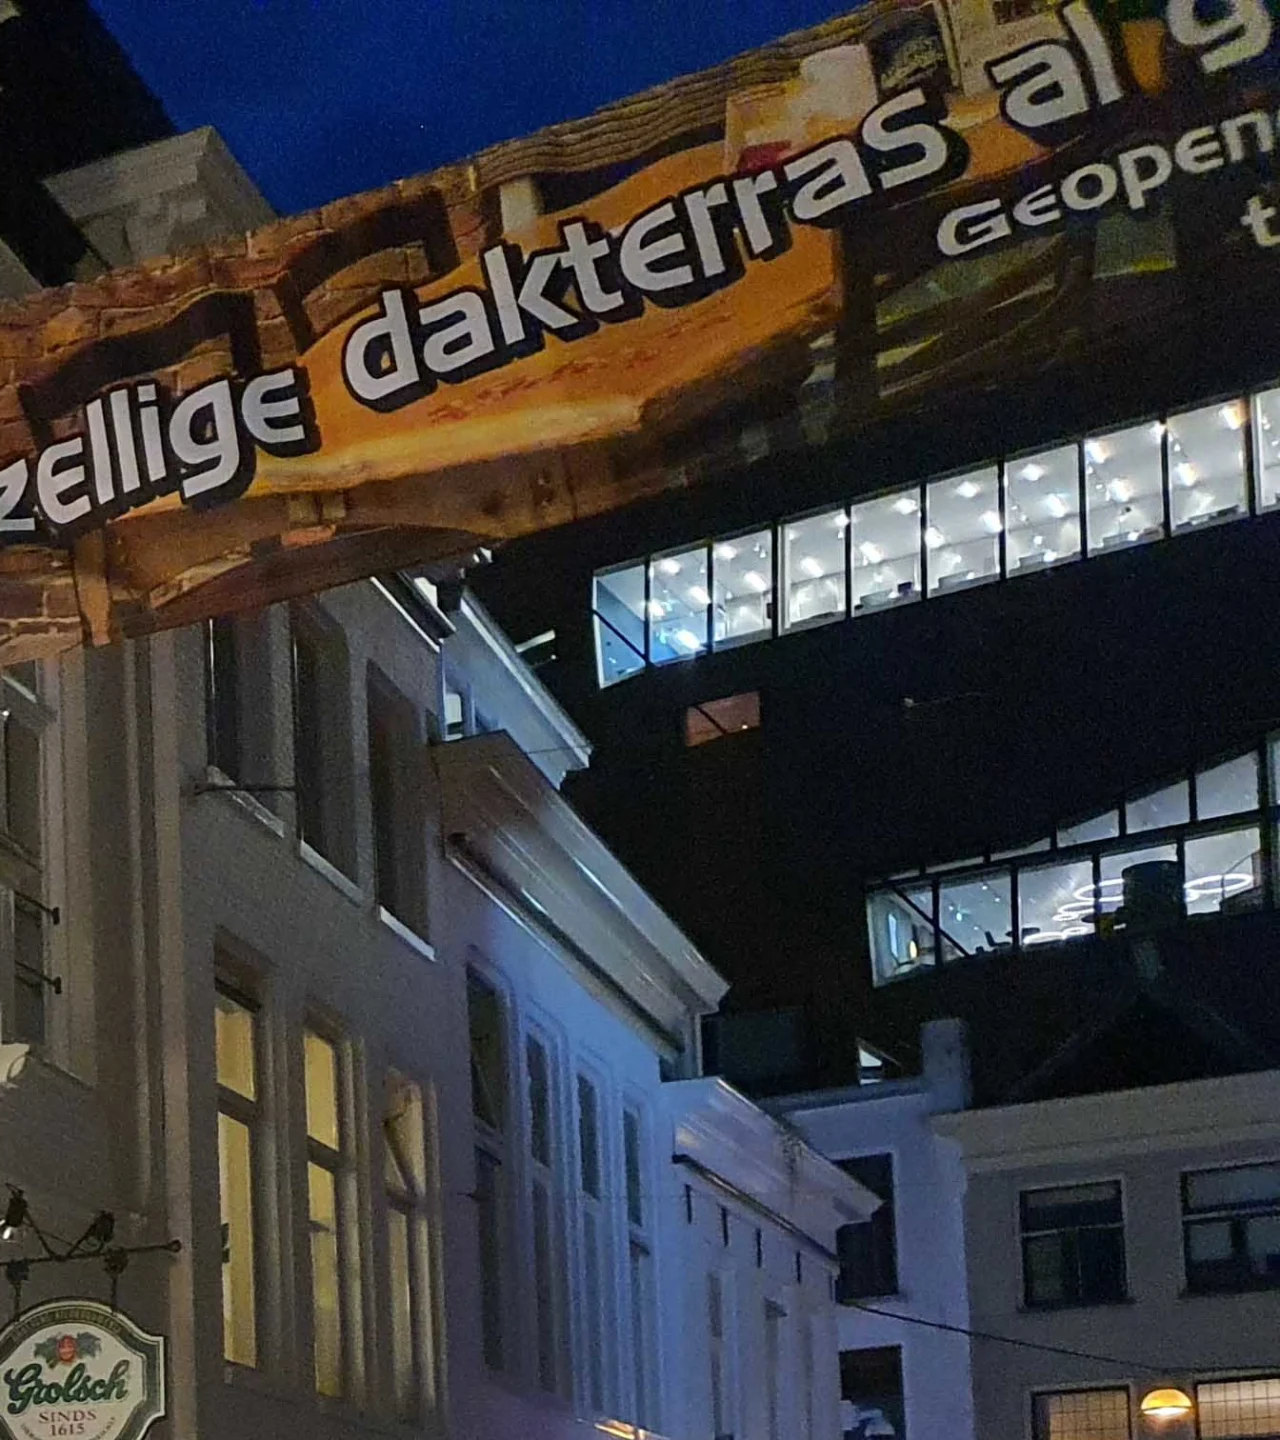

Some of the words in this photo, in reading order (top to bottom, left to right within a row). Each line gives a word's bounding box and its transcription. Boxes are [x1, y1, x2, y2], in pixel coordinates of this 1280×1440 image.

[344, 88, 948, 400] dakterras
[990, 0, 1124, 128] al
[937, 107, 1280, 257] Geopen
[3, 1358, 132, 1415] Grolsch
[38, 1408, 98, 1425] SINDS
[48, 1423, 86, 1438] 1615
